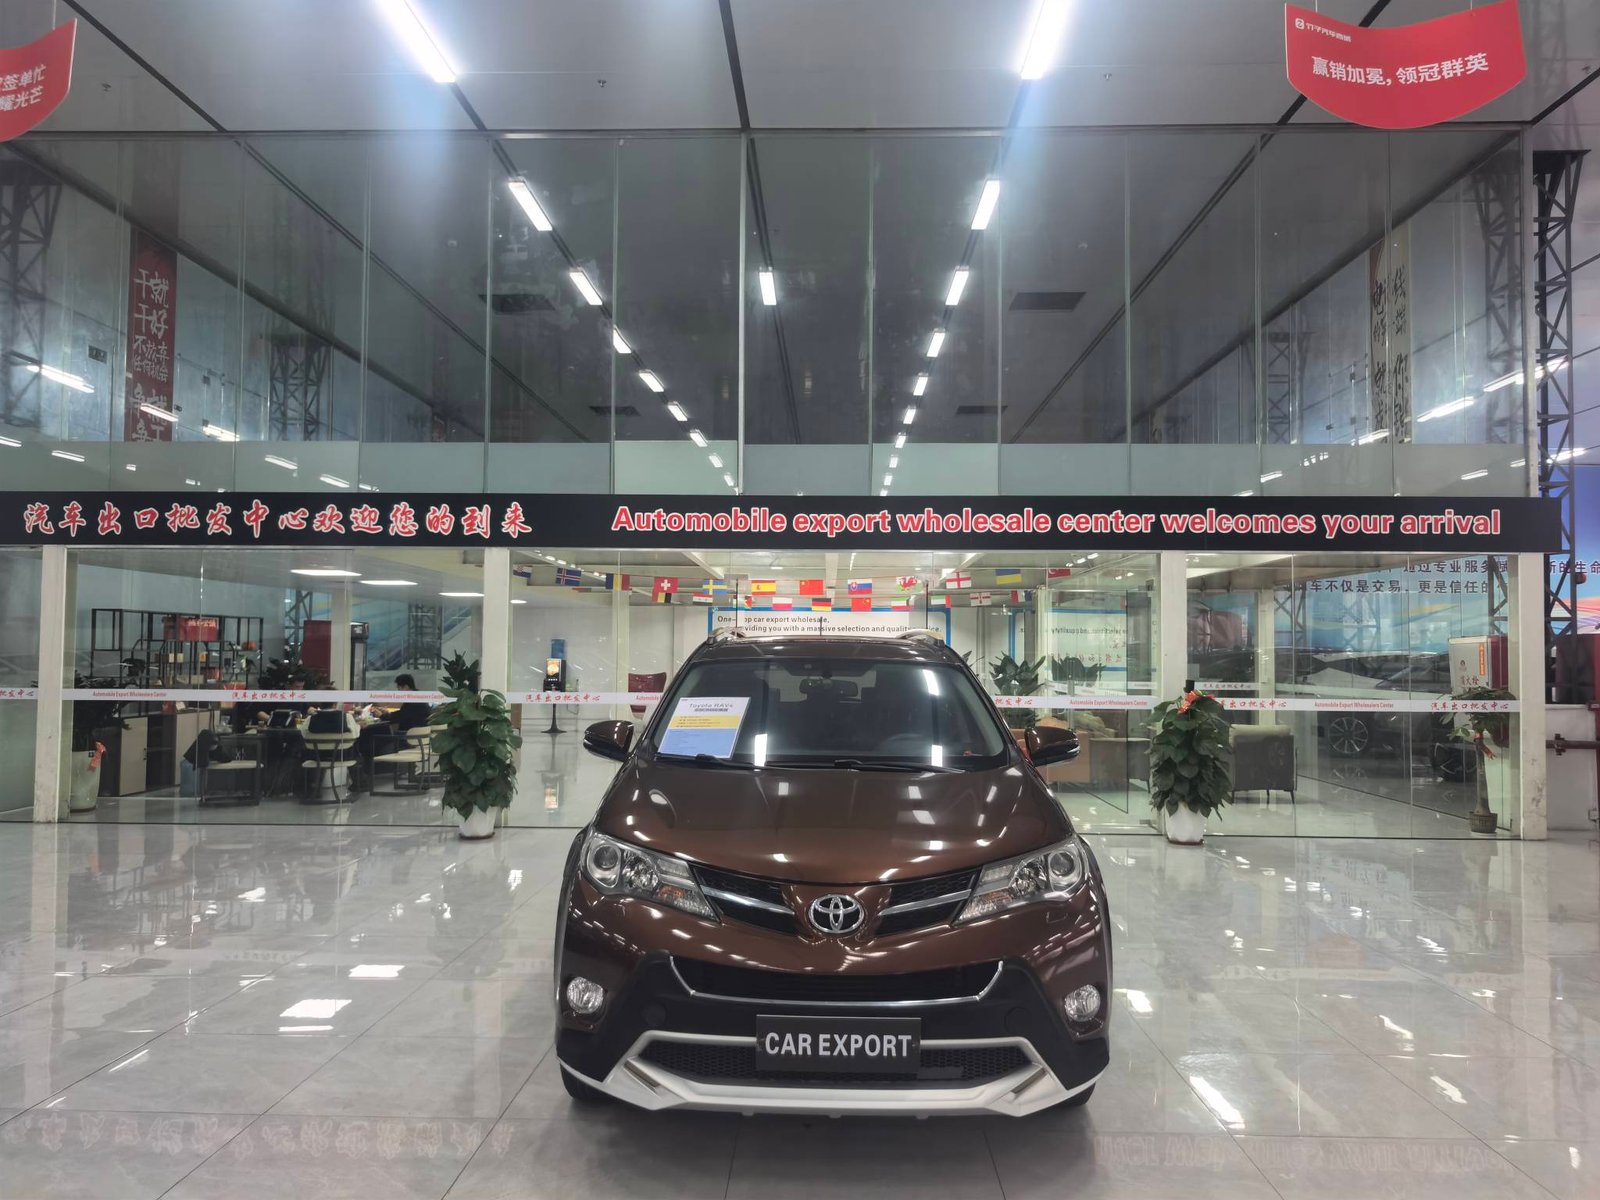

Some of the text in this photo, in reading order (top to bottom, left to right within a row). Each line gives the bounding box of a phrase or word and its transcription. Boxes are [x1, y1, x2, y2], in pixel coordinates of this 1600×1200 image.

[0, 63, 47, 92] 签单忙
[23, 498, 533, 539] 汽车出口批发中心欢迎您的到来
[611, 506, 1501, 539] Automobile export wholesale center welcomes your arrival
[765, 616, 789, 625] export
[768, 626, 781, 634] you
[1431, 701, 1509, 711] 汽车出口批发中心
[765, 1032, 912, 1057] CAR EXPORT
